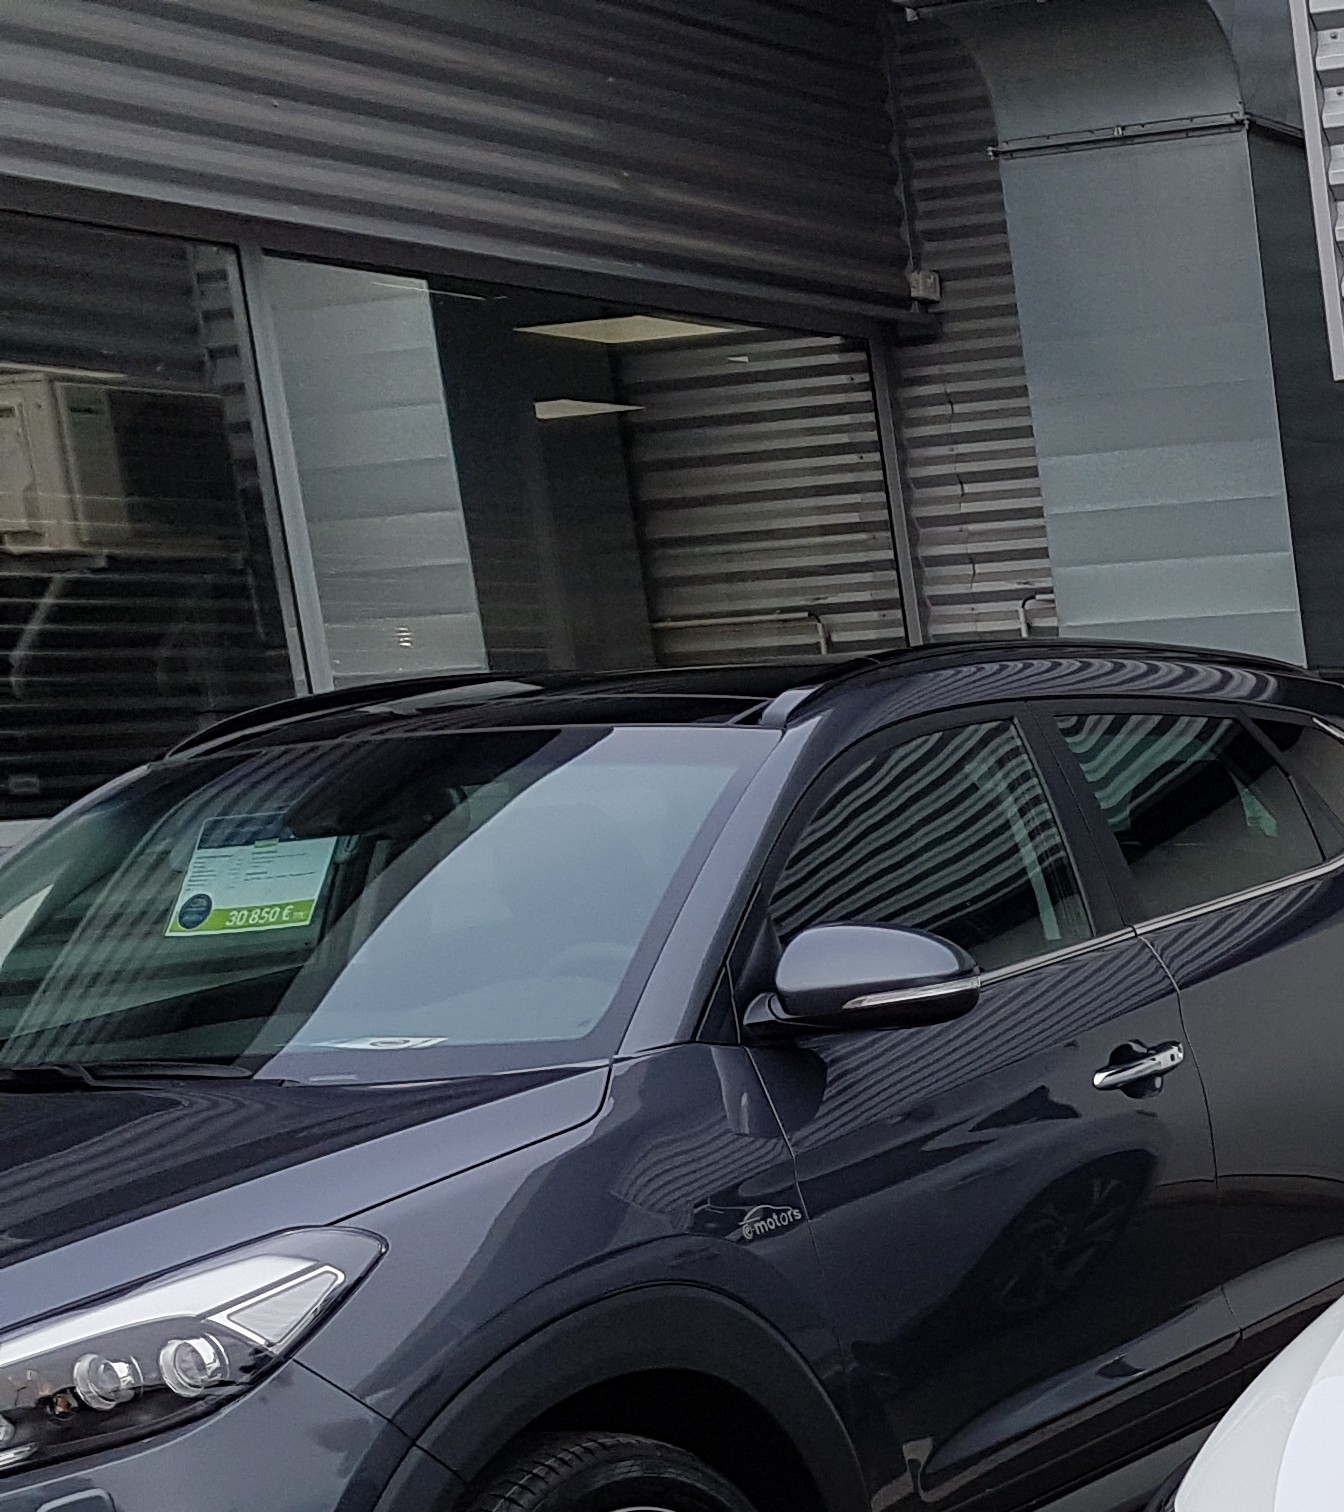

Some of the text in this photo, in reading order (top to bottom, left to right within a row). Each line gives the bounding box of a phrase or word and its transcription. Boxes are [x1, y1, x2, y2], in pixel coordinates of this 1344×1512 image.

[225, 910, 248, 926] 30
[249, 907, 280, 924] 850
[282, 905, 294, 921] €
